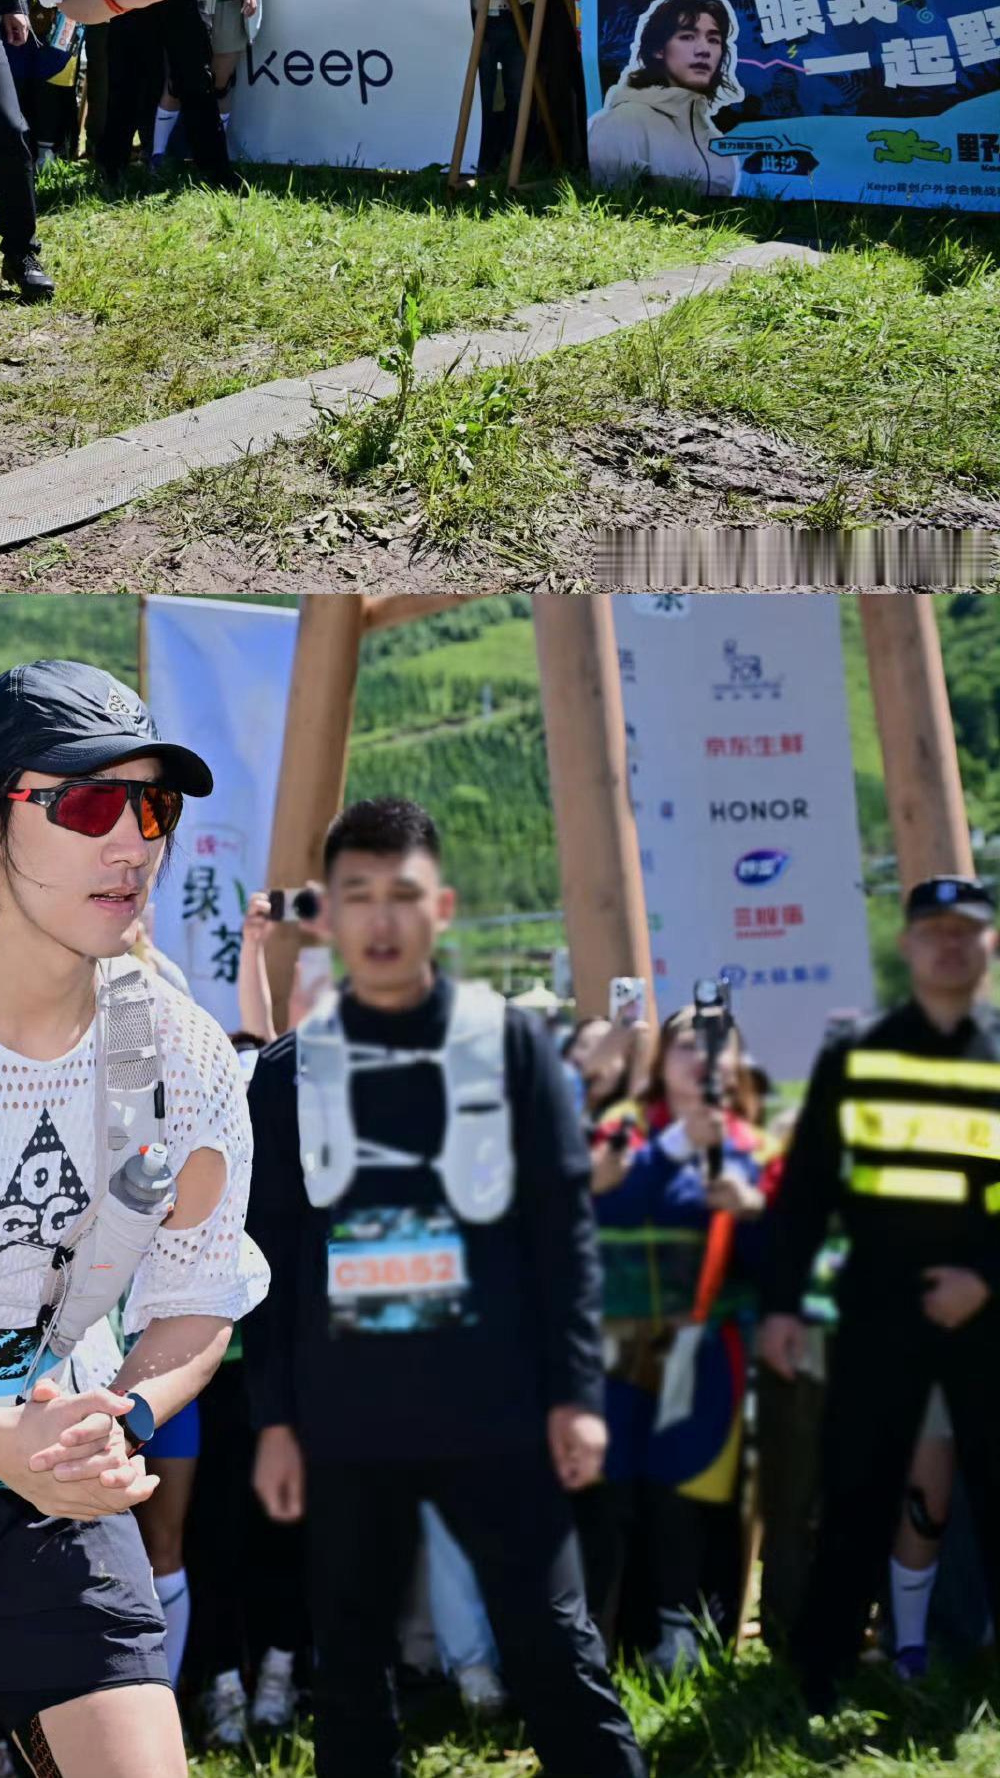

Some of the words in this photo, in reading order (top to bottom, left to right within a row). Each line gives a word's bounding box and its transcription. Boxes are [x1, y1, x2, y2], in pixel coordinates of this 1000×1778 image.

[246, 43, 393, 105] keep
[957, 133, 1000, 162] 野
[761, 155, 798, 172] 此沙
[709, 798, 810, 822] HONOR
